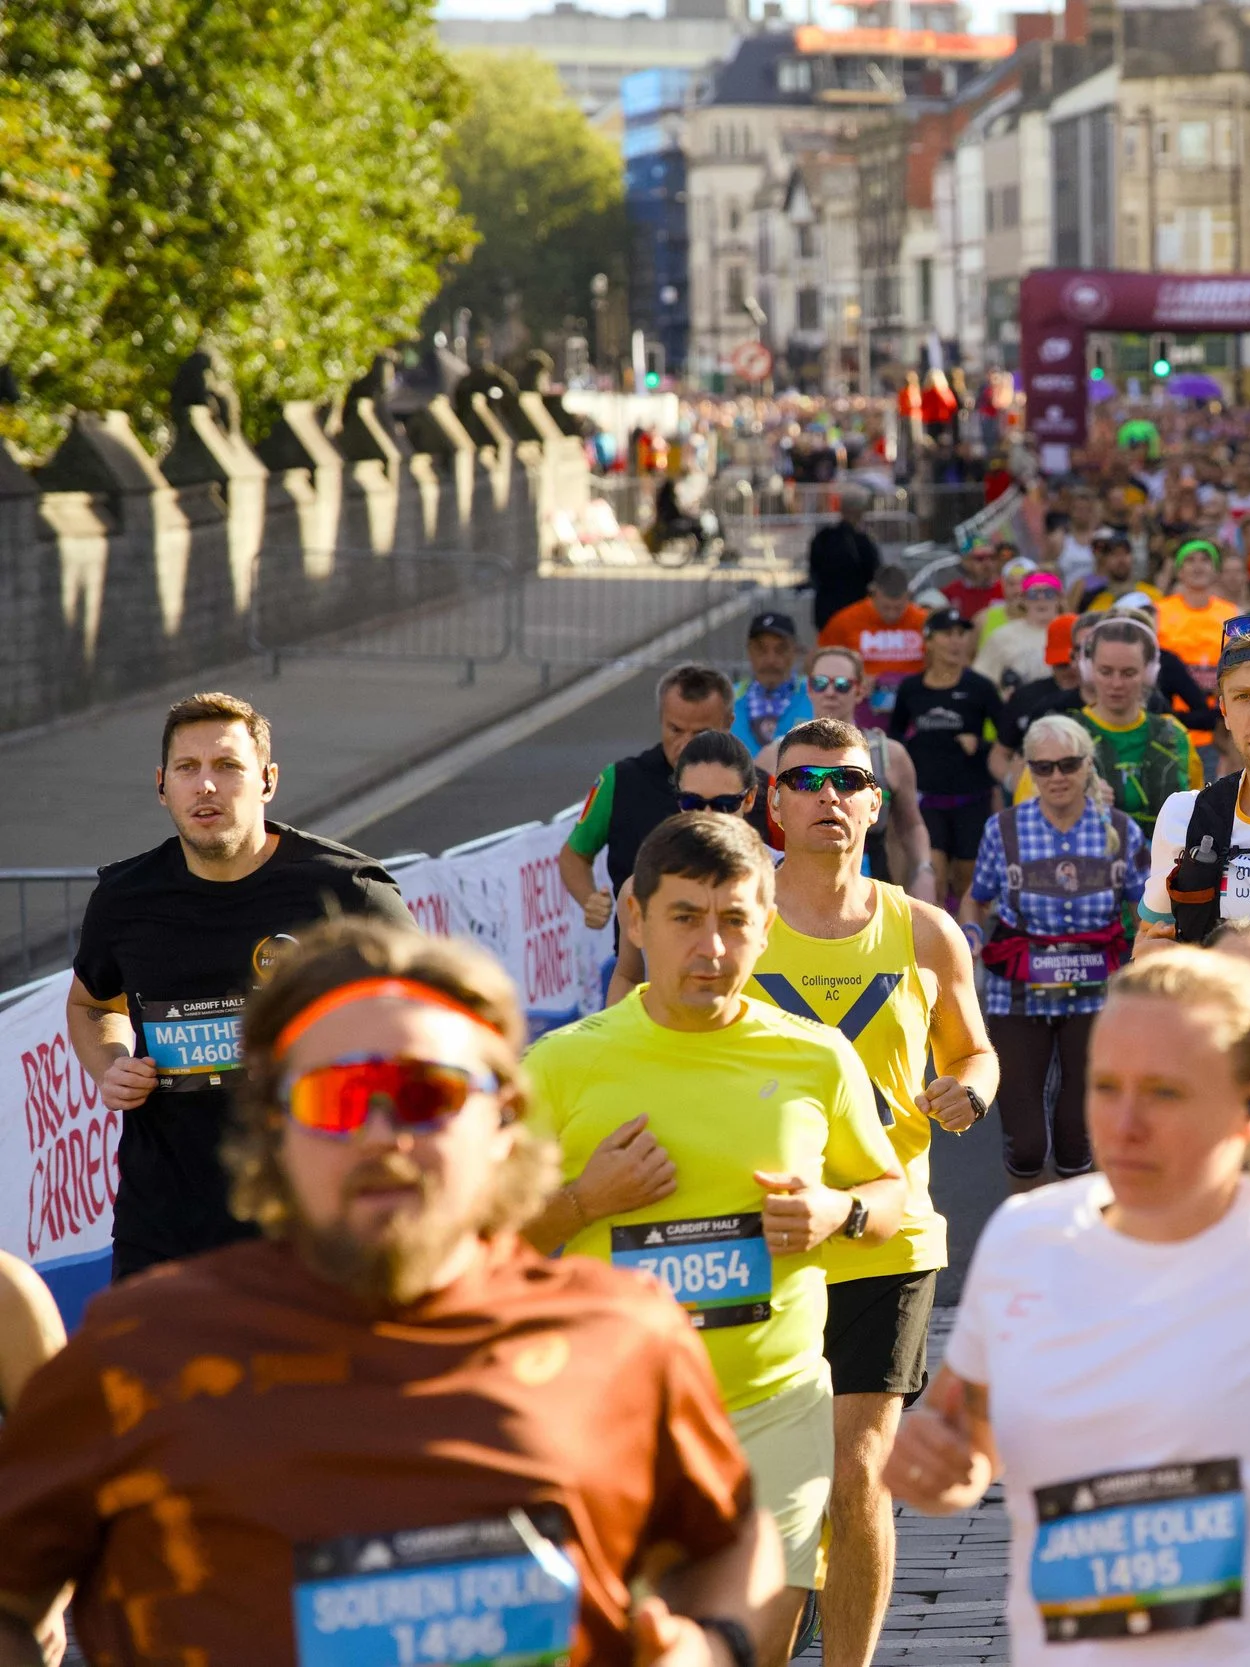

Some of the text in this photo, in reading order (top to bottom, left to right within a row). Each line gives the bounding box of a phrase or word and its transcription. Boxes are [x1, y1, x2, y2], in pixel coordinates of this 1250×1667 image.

[801, 974, 862, 988] Collingwood
[1054, 968, 1088, 981] 6724
[825, 990, 840, 1001] AC
[183, 998, 246, 1012] CARDIFF HALF
[155, 1020, 243, 1045] MATTHE
[666, 1218, 741, 1235] CARDIFF HALF
[1131, 1502, 1236, 1546] FOLKE
[1088, 1546, 1181, 1594] 1495
